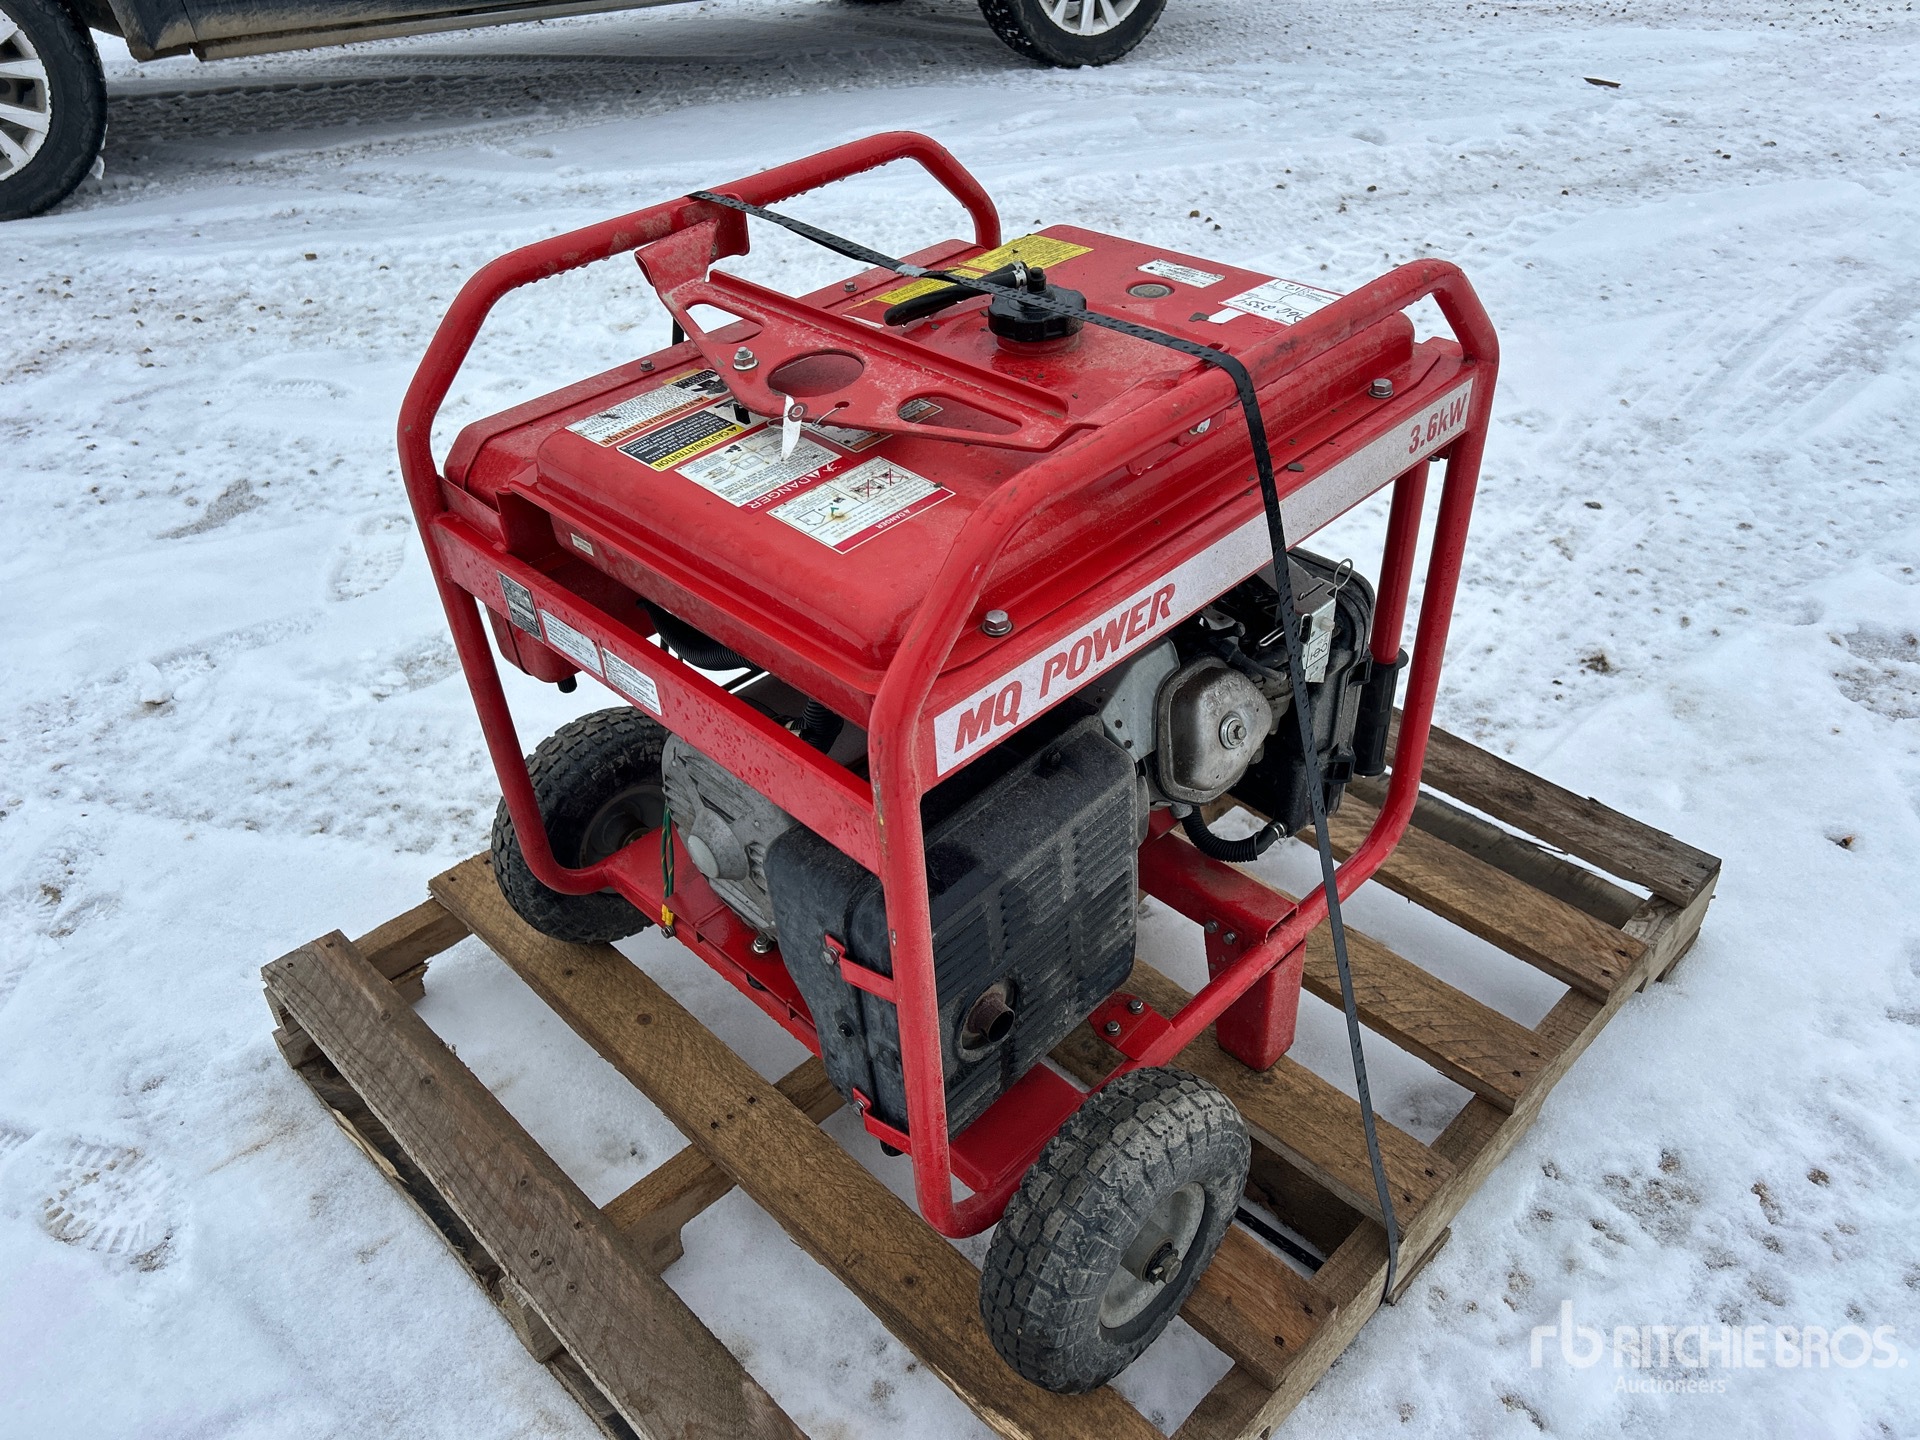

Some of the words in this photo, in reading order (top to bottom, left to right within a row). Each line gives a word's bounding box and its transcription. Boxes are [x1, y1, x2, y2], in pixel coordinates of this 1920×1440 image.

[1408, 392, 1468, 454] 3.6kW
[651, 430, 732, 468] CAUTION/ATTENTION
[748, 476, 812, 509] DANGER
[873, 511, 906, 529] DANGER
[955, 681, 1022, 753] MQ
[1040, 583, 1176, 698] POWER
